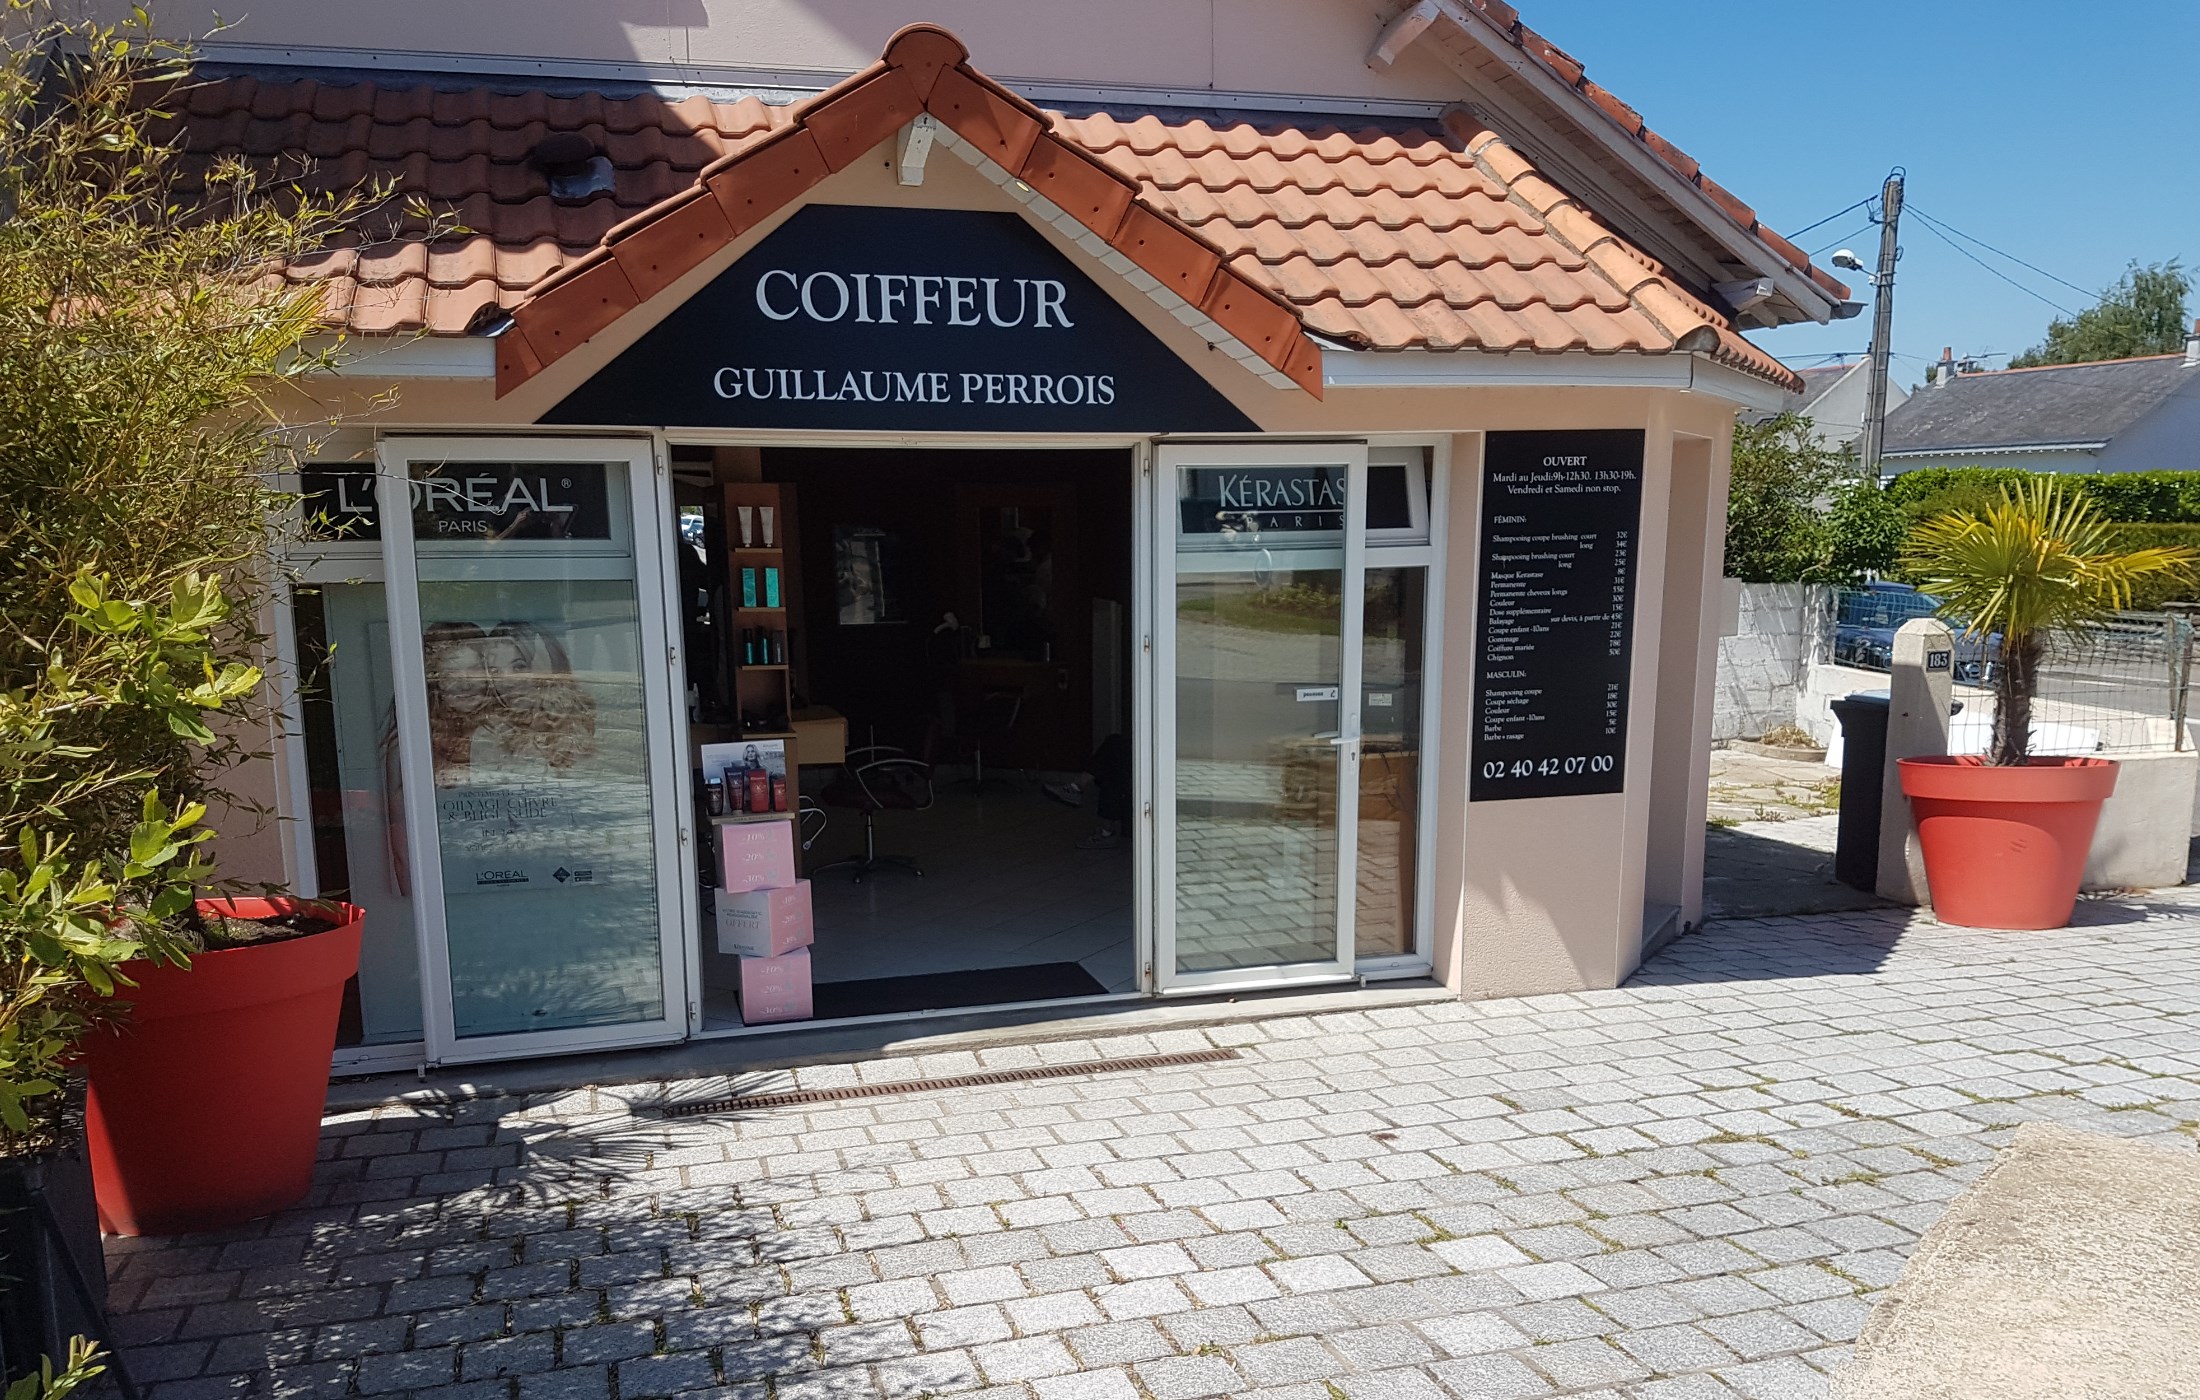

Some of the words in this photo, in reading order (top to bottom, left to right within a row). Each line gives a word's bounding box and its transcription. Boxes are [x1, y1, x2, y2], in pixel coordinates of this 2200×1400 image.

[756, 269, 1074, 328] COIFFEUR
[713, 367, 951, 403] GUILLAUME
[959, 373, 1115, 405] PERROIS
[1543, 456, 1587, 466] OUVERT
[1493, 473, 1517, 482] Mardi
[1507, 485, 1543, 494] Vendredi
[1554, 484, 1583, 493] Samedi
[1603, 485, 1621, 494] stop.
[1247, 515, 1345, 528] PARIS
[1494, 515, 1526, 523] FÉMININ:
[438, 520, 487, 532] PARIS
[1492, 535, 1530, 543] Shampooing
[1552, 534, 1578, 542] brushing
[1492, 554, 1529, 562] Shampooing
[1531, 552, 1557, 560] brushing
[1558, 561, 1572, 569] long
[1491, 572, 1514, 580] Masque
[1490, 618, 1514, 626] Balayage
[1584, 614, 1601, 622] partir
[1488, 636, 1519, 644] Gommage
[1930, 653, 1947, 667] 183
[1487, 671, 1526, 679] MASCULIN:
[1486, 689, 1523, 697] Shampooing
[1485, 716, 1504, 724] Coupe
[1484, 761, 1504, 778] 02
[1511, 760, 1533, 778] 40
[1538, 758, 1559, 776] 42
[1565, 757, 1586, 774] 07
[1591, 755, 1613, 772] 00
